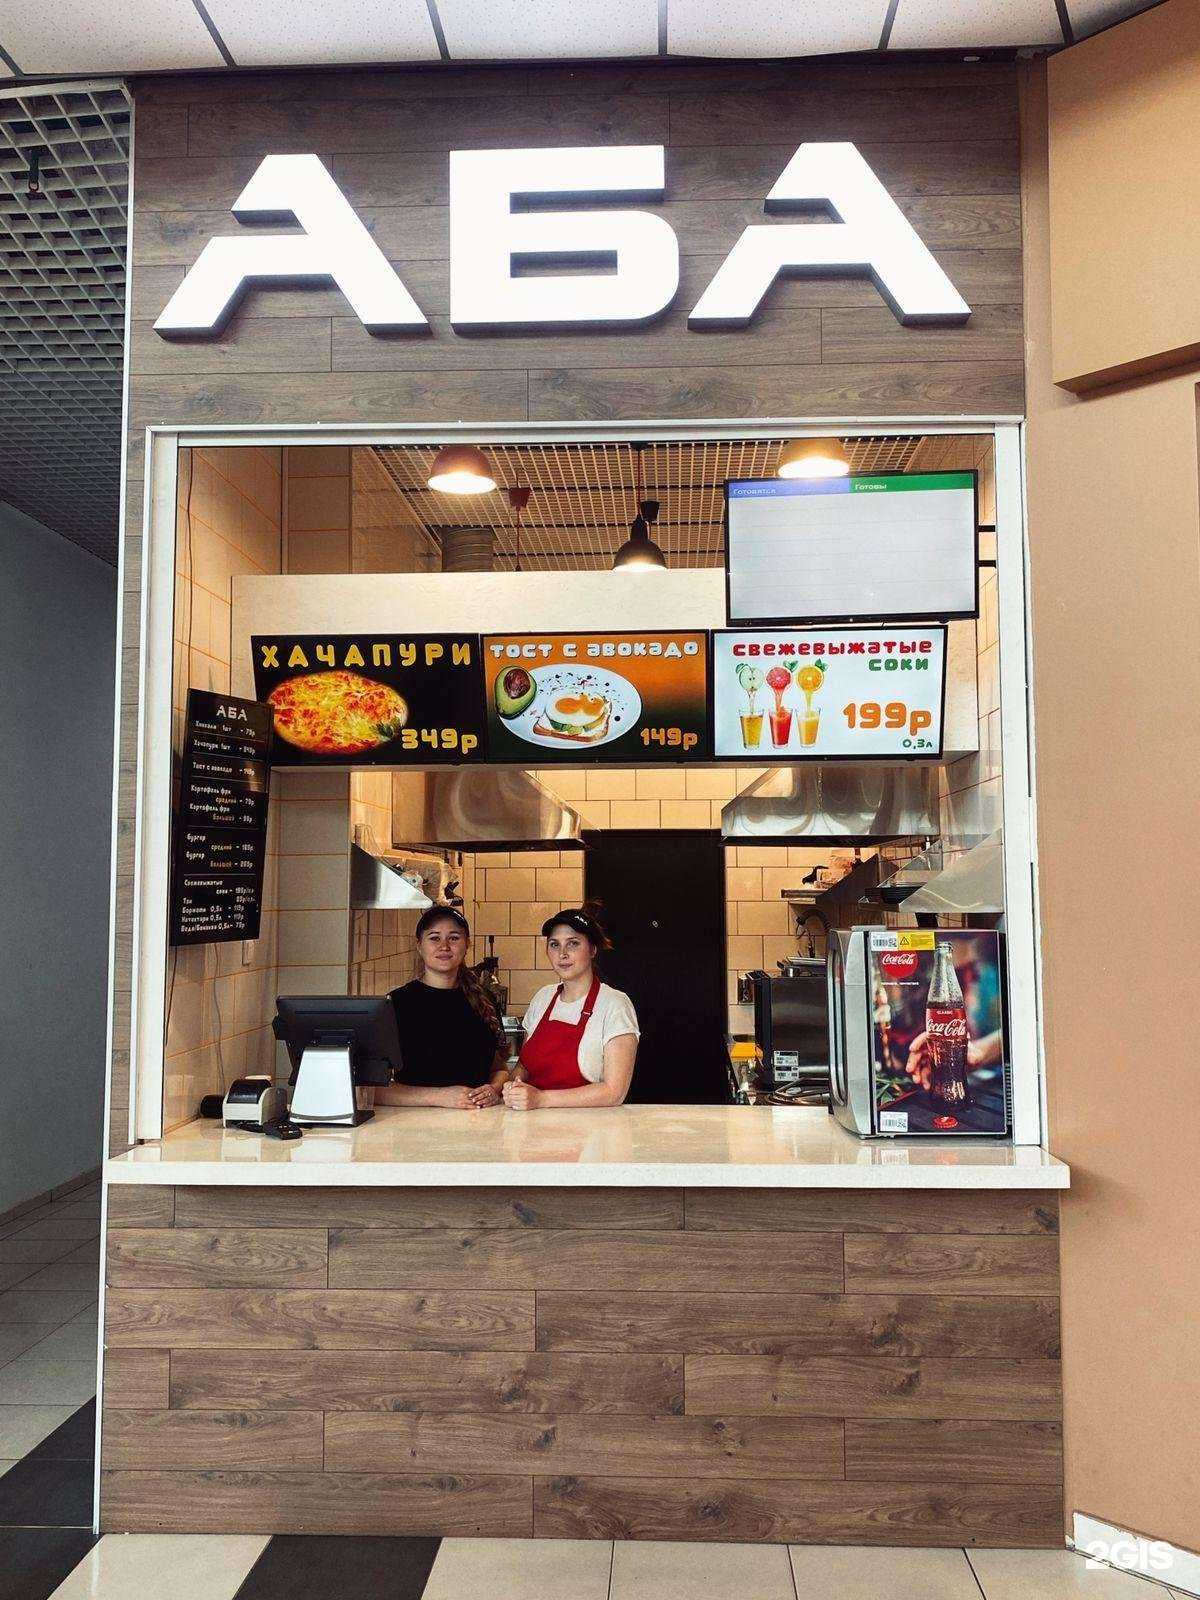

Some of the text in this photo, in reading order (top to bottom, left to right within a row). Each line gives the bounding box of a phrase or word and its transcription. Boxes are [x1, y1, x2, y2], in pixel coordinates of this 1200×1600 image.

[152, 141, 972, 340] АБА
[261, 643, 471, 668] ХАЧАПУРИ
[216, 704, 248, 722] АБА
[842, 702, 932, 736] 199р
[400, 728, 479, 755] 349р
[640, 727, 699, 751] 149р
[902, 738, 934, 751] 0,3л
[192, 761, 206, 770] Тост
[190, 784, 220, 795] Картофель
[189, 803, 219, 814] Картофель
[882, 953, 916, 966] Coca-Cola
